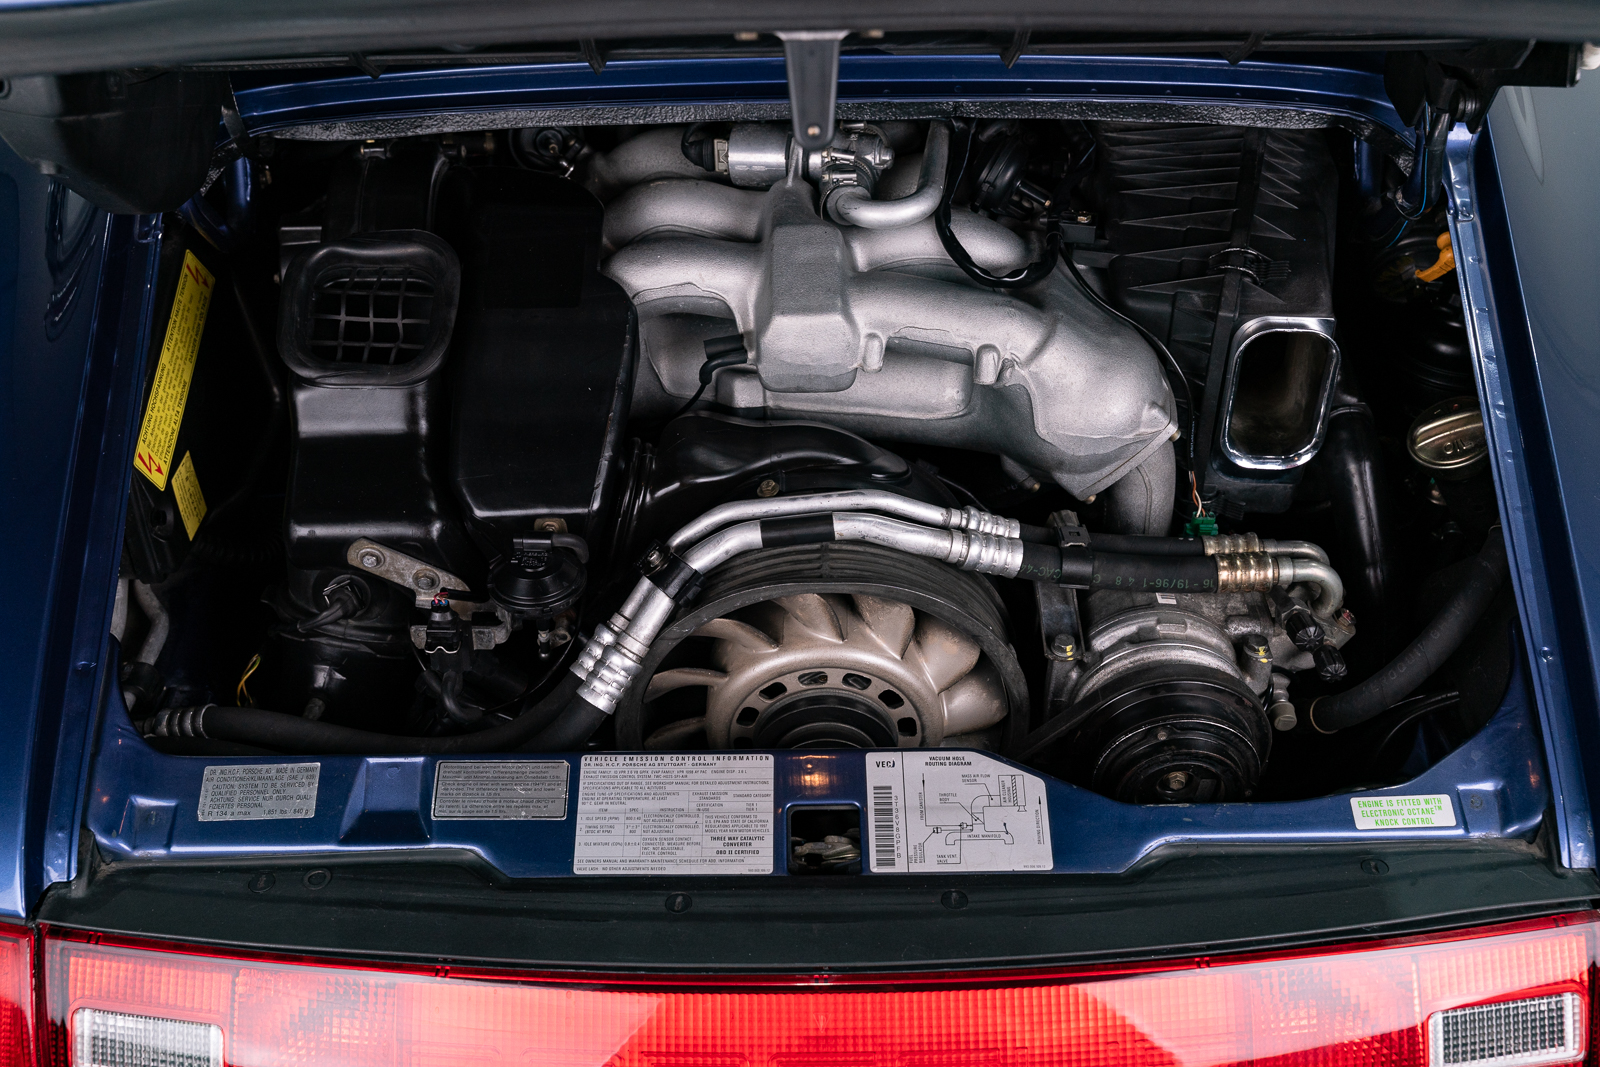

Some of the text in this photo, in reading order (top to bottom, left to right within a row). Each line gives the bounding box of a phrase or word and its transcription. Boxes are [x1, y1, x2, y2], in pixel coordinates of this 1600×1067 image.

[166, 272, 189, 352] ATTENTION HAUTE TENSION
[188, 337, 198, 364] DANGER
[199, 295, 208, 322] VOLTAGE
[142, 363, 167, 444] ACHTUNG HOCHSPANNUNG
[163, 379, 188, 465] ATTENZIONE ALTA TENSIONE
[1443, 438, 1474, 455] OIL
[1357, 797, 1442, 808] ENGINE IS FITTED WITH
[1361, 809, 1405, 817] ELECTRONIC
[1374, 817, 1434, 826] KNOCK CONTROL
